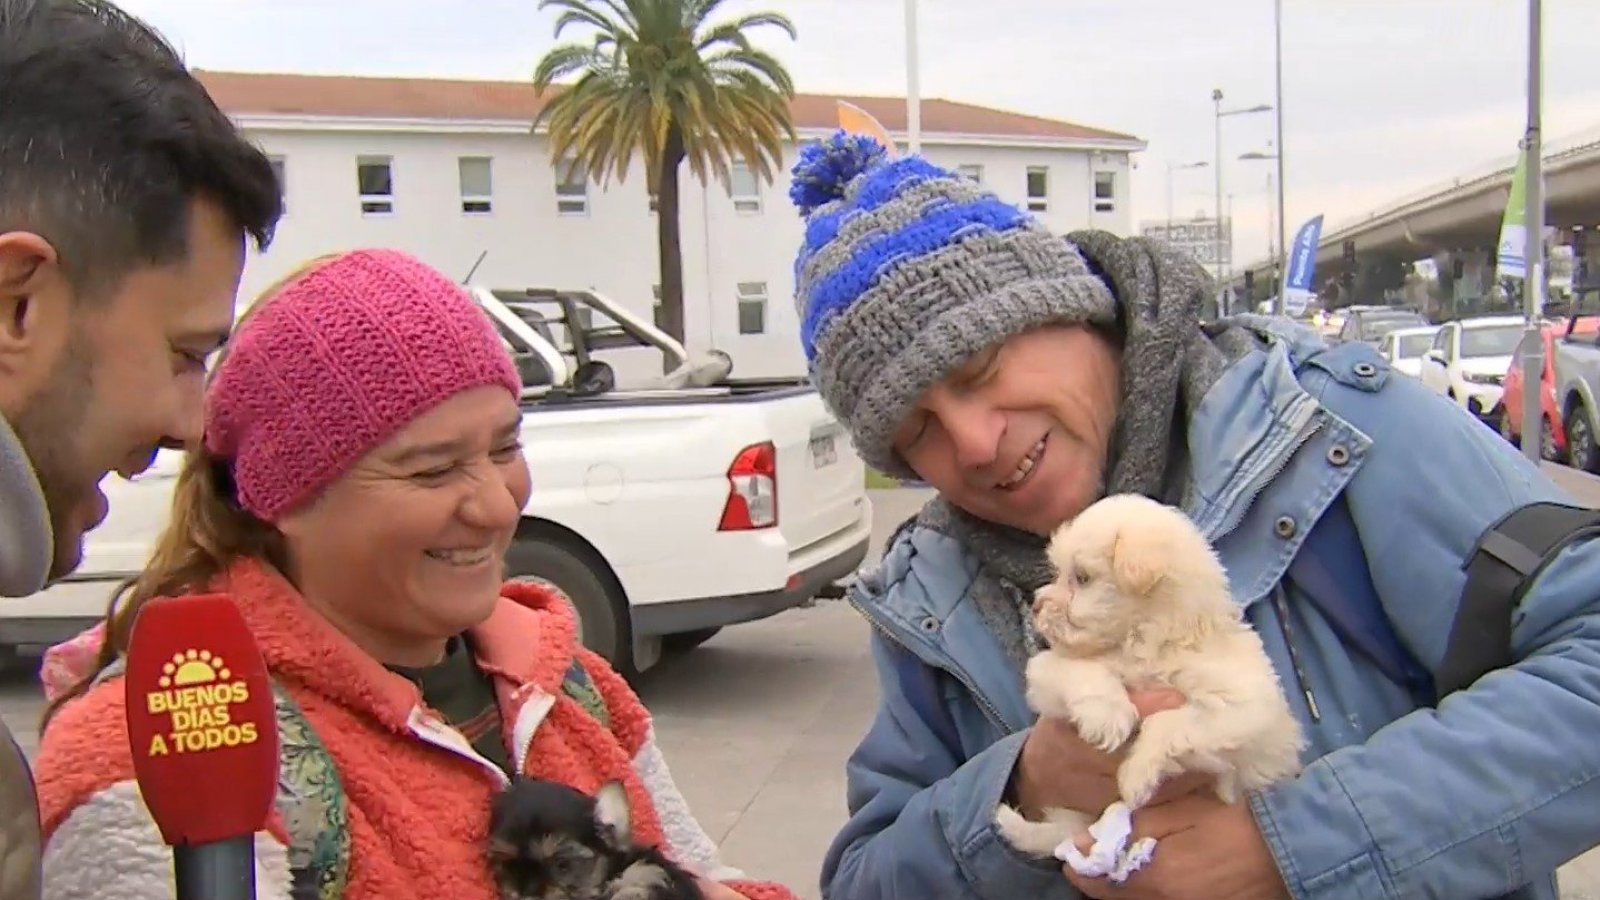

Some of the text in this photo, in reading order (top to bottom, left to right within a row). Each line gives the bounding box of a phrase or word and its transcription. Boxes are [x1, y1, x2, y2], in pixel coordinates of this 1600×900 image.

[147, 681, 249, 713] BUENOS
[149, 722, 258, 756] A TODOS
